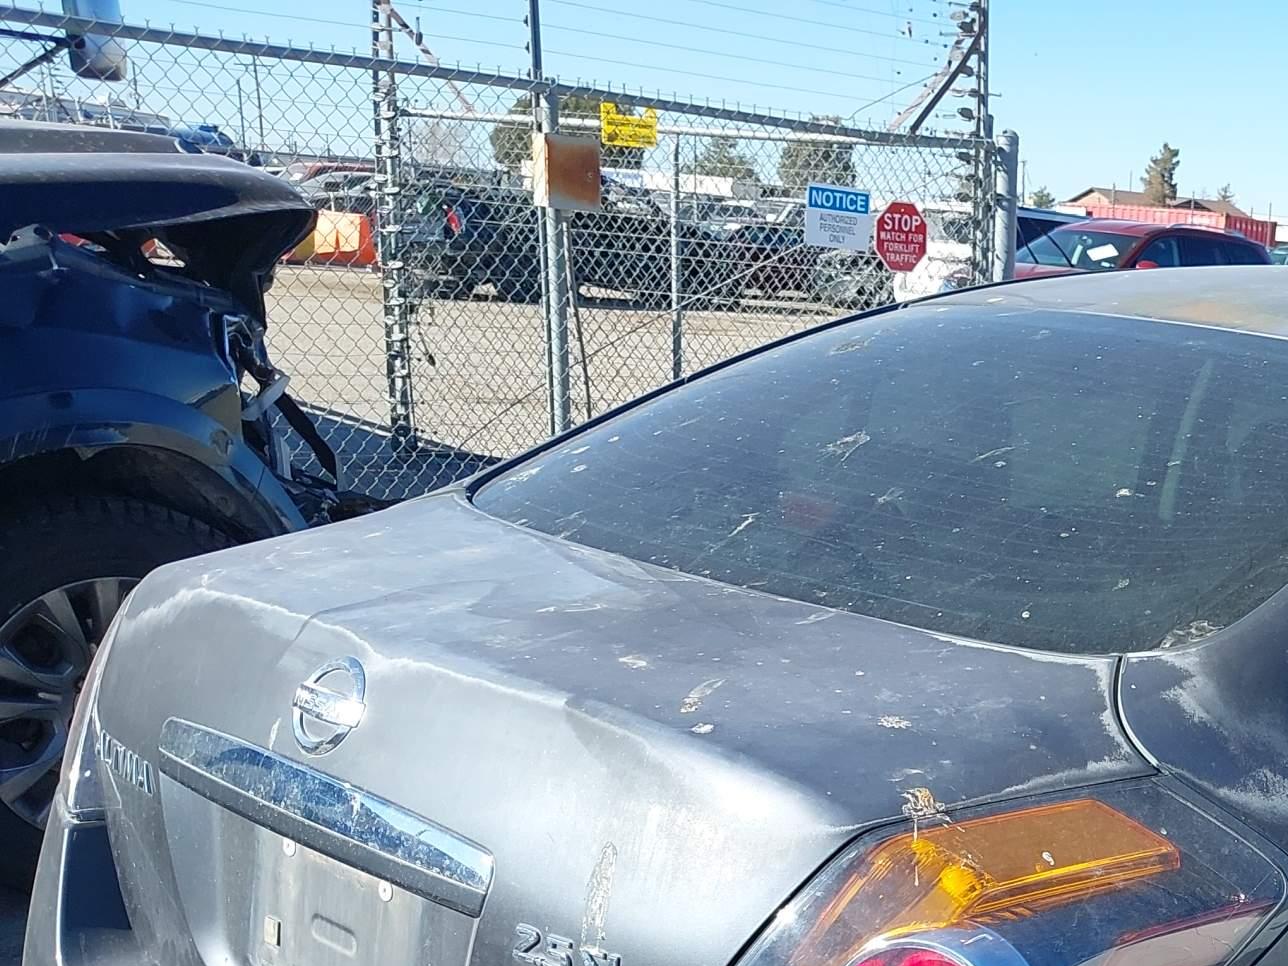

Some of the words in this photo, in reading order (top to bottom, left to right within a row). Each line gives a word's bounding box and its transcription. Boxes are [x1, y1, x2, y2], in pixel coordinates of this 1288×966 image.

[811, 189, 866, 212] NOTICE
[819, 213, 857, 226] AUTHORIZED
[883, 212, 921, 232] STOP
[819, 222, 856, 236] PERSONNEL
[829, 233, 845, 244] ONLY
[879, 230, 906, 242] WATCH
[908, 232, 924, 243] FOR
[883, 241, 920, 253] FORKLIFT
[886, 252, 918, 264] TRAFFIC
[294, 687, 355, 724] NISSA
